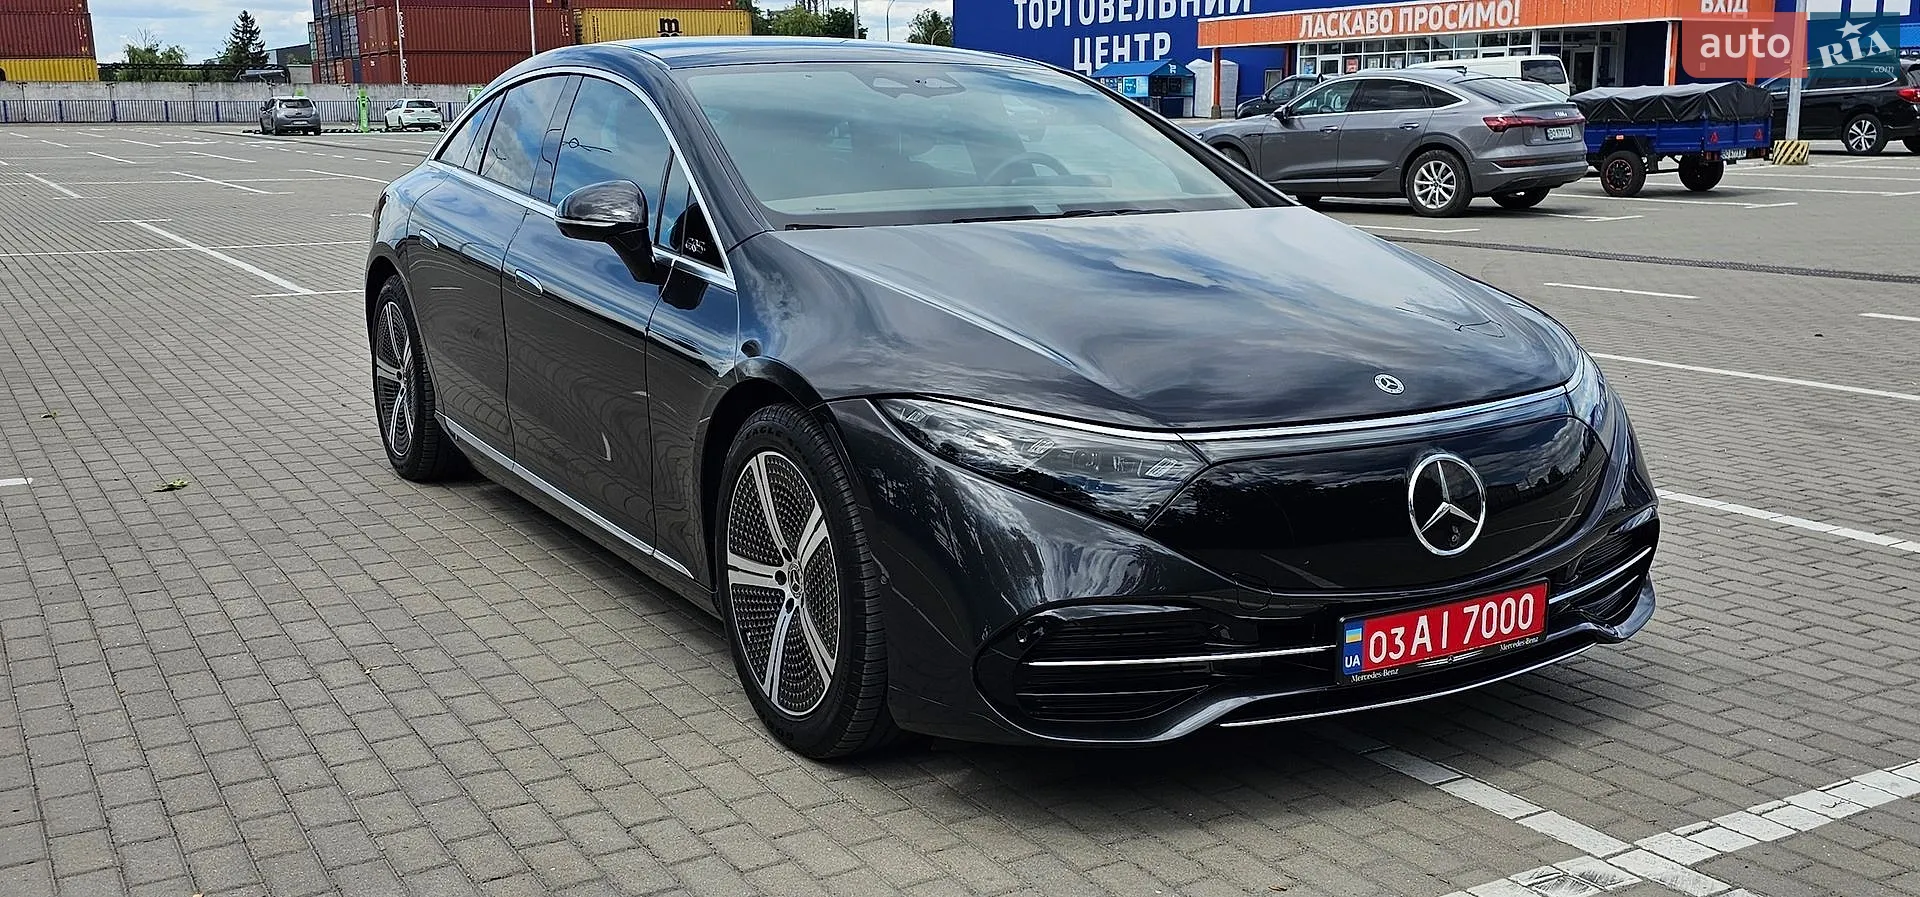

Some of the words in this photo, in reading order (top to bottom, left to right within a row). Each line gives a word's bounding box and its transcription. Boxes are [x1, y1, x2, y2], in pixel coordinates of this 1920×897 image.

[1299, 8, 1394, 38] ЛАСКАВО
[1399, 0, 1521, 32] ПРОСИМО!
[1073, 32, 1171, 75] ЦЕНТР
[1345, 655, 1360, 667] UA
